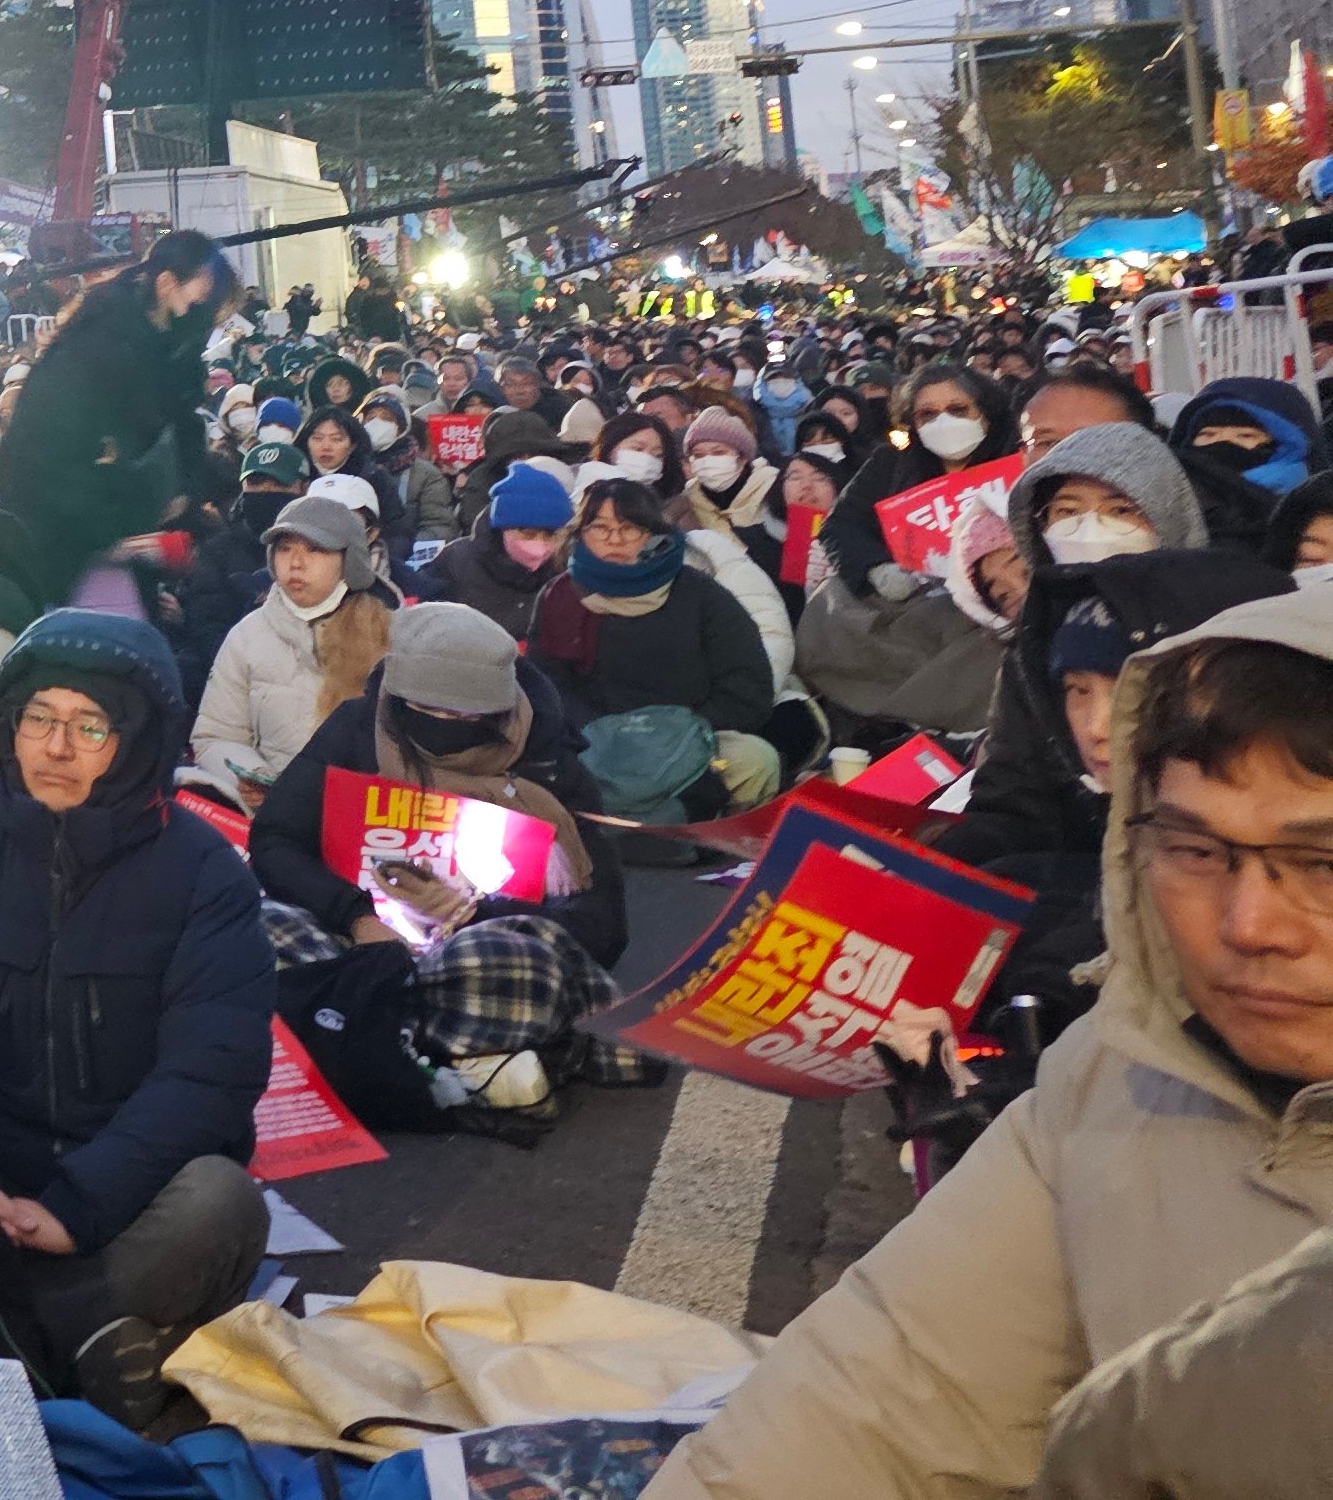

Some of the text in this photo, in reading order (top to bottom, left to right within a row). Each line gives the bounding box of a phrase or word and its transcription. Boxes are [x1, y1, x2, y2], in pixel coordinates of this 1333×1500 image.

[442, 425, 482, 443] 내란수
[363, 785, 460, 833] 내란
[671, 901, 848, 1048] 내란죄
[744, 930, 915, 1080] 윤석열
